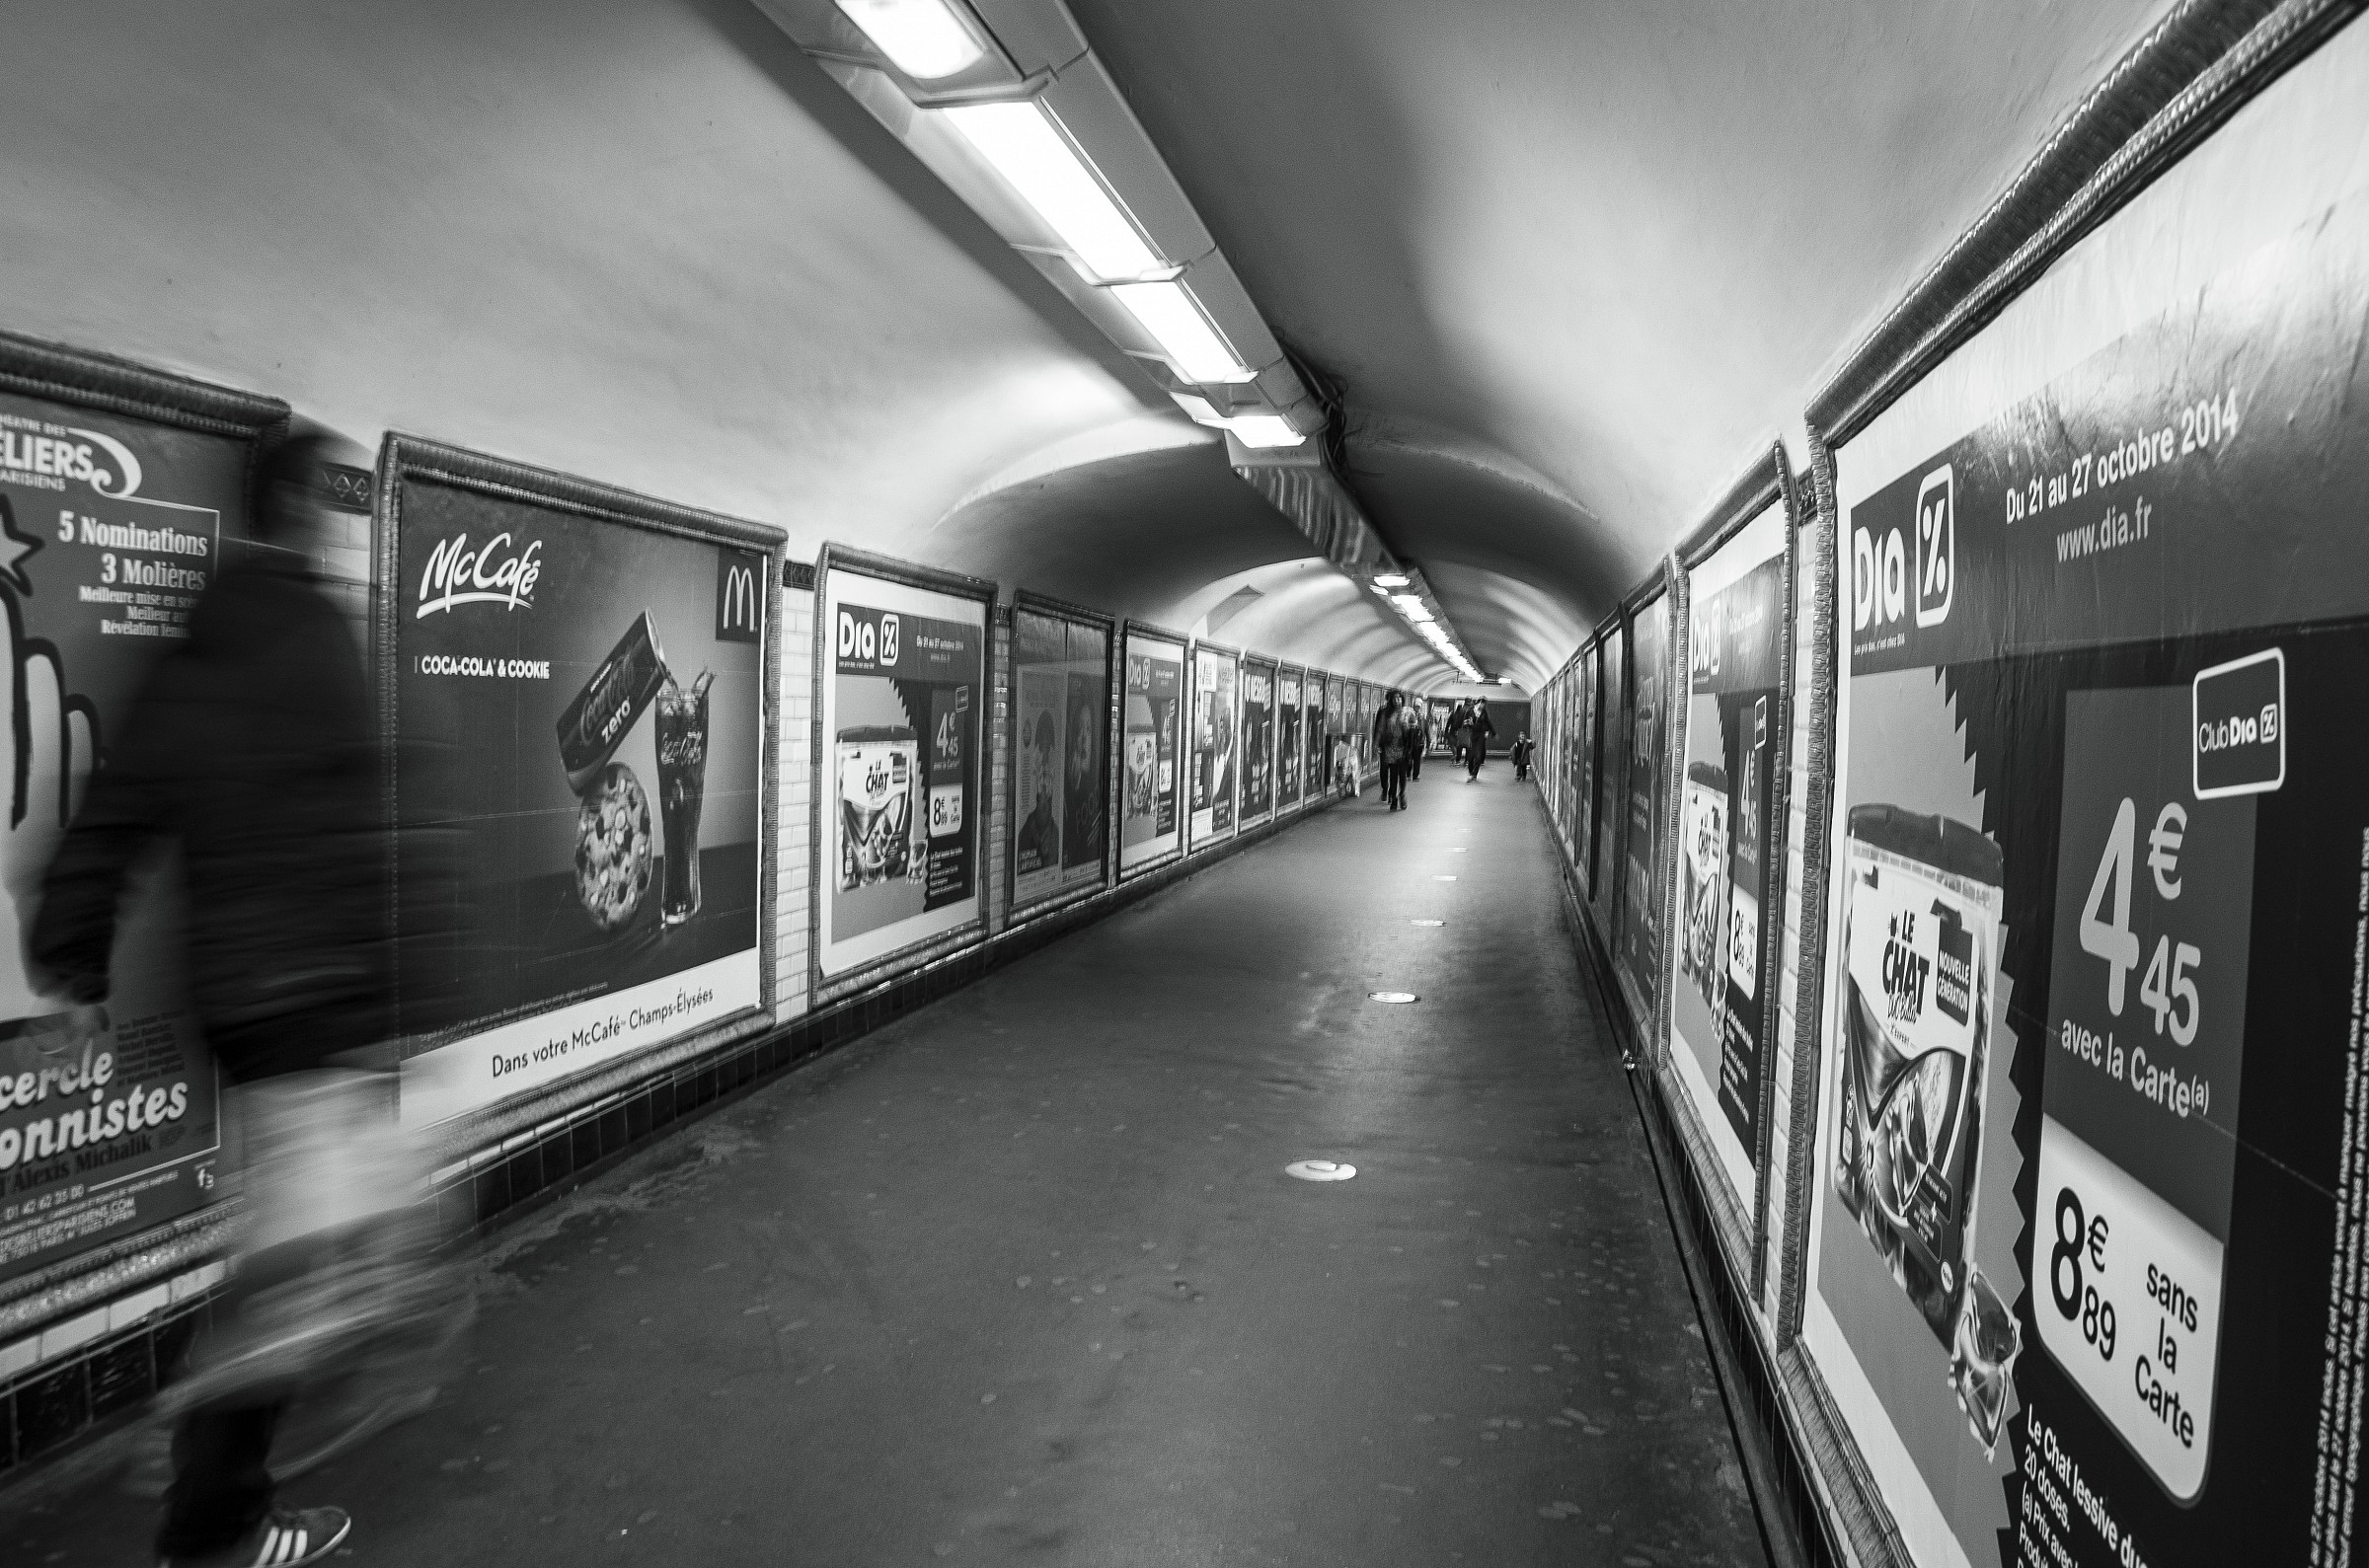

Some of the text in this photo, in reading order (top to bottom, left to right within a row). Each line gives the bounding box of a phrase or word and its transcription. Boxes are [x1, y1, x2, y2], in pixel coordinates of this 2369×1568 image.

[2006, 387, 2239, 524] Du 21 au 27 octobre 2014
[58, 511, 208, 557] 5 Nominations
[2056, 495, 2152, 563] www.dia.fr
[101, 553, 206, 591] 3 Molières
[419, 533, 542, 614] McCafé
[497, 658, 506, 677] &
[508, 660, 550, 679] COOKIE
[601, 696, 631, 745] zero
[866, 772, 888, 793] CHAT
[1901, 909, 1915, 944] LE
[1882, 937, 1930, 1015] CHAT
[1938, 976, 1968, 1014] GÉNÉRATION
[1939, 949, 1969, 986] NOUVELLE
[493, 1052, 528, 1079] Dans
[532, 1036, 568, 1064] votre
[629, 988, 714, 1029] Champs-Élysées
[2061, 1018, 2102, 1068] avec
[2106, 1031, 2123, 1083] la
[0, 1039, 114, 1112] cercle
[75, 1135, 151, 1173] Michalik
[2147, 1263, 2197, 1333] sans
[2158, 1317, 2178, 1375] la
[2135, 1355, 2194, 1449] Carte
[2025, 1444, 2071, 1532] 20 doses.
[2028, 1403, 2041, 1447] Le
[2044, 1427, 2071, 1489] Chat
[2073, 1463, 2117, 1550] lessive
[2023, 1480, 2032, 1523] (a)
[2033, 1500, 2050, 1546] Prix
